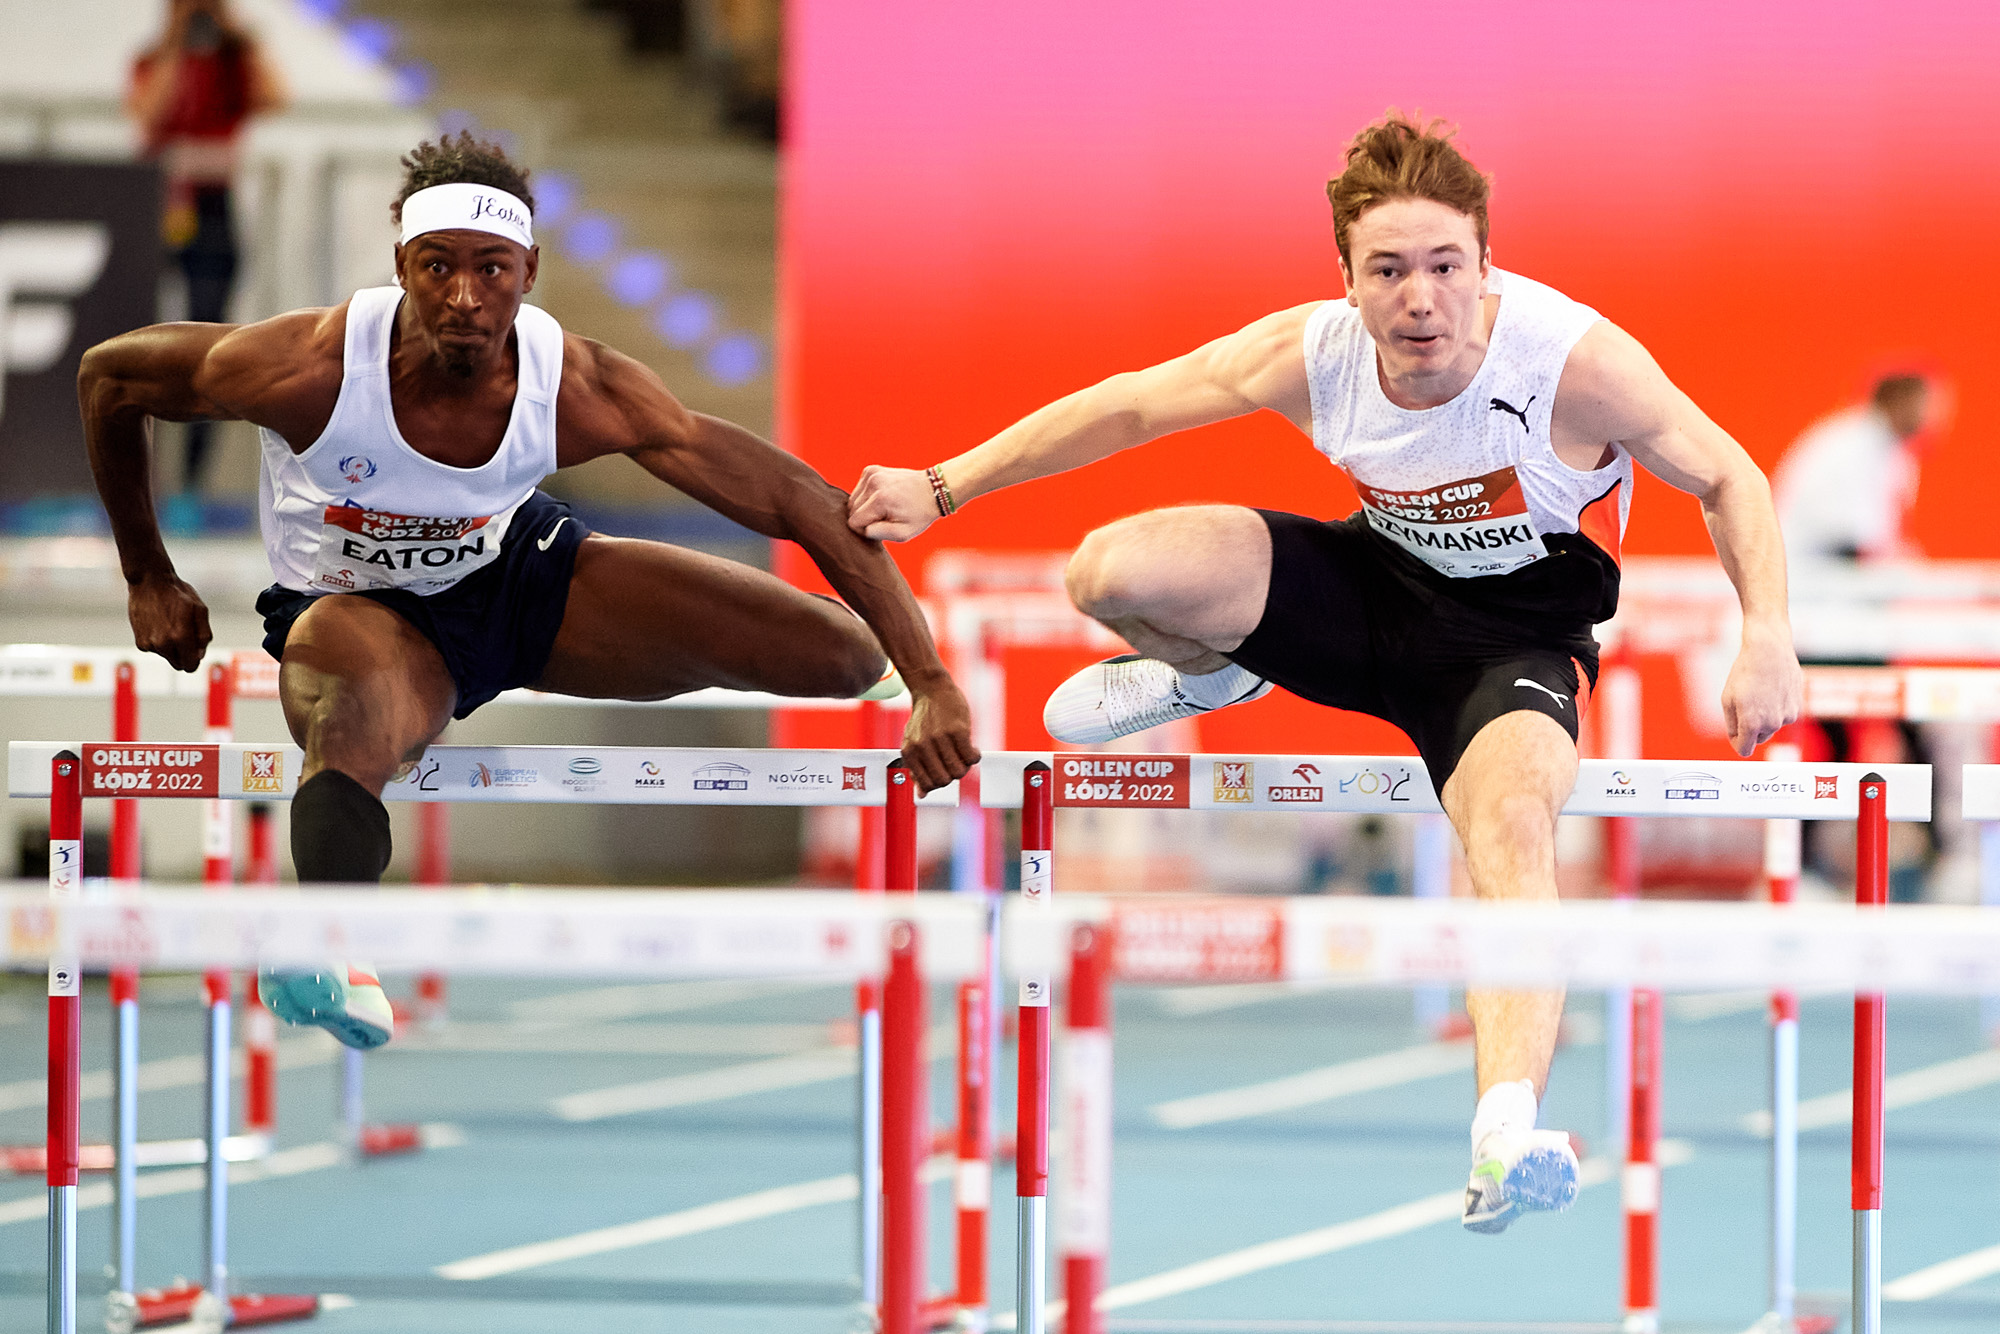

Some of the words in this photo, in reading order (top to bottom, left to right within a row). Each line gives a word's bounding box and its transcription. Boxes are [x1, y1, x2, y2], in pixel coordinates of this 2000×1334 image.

[1369, 489, 1440, 507] ORLEN
[1441, 482, 1485, 502] CUP
[1377, 501, 1438, 521] ŁÓDŹ
[1440, 501, 1492, 520] 2022
[362, 513, 434, 527] ORLEN
[361, 521, 423, 539] ŁÓDŹ
[342, 536, 485, 570] EATON
[323, 575, 354, 588] ORLEN
[92, 750, 162, 767] ORLEN
[164, 750, 203, 767] CUP
[1063, 760, 1132, 777] ORLEN
[1134, 761, 1174, 778] CUP
[93, 768, 152, 790] ŁÓDŹ
[156, 773, 203, 790] 2022
[245, 778, 281, 790] PZLA
[768, 774, 834, 784] NOVOTEL
[845, 772, 863, 783] ibis
[1064, 779, 1124, 801] ŁÓDŹ
[1127, 784, 1175, 801] 2022
[1740, 783, 1805, 793] NOVOTEL
[1817, 781, 1836, 792] ibis
[1215, 789, 1251, 801] PZLA
[1270, 788, 1320, 801] ORLEN
